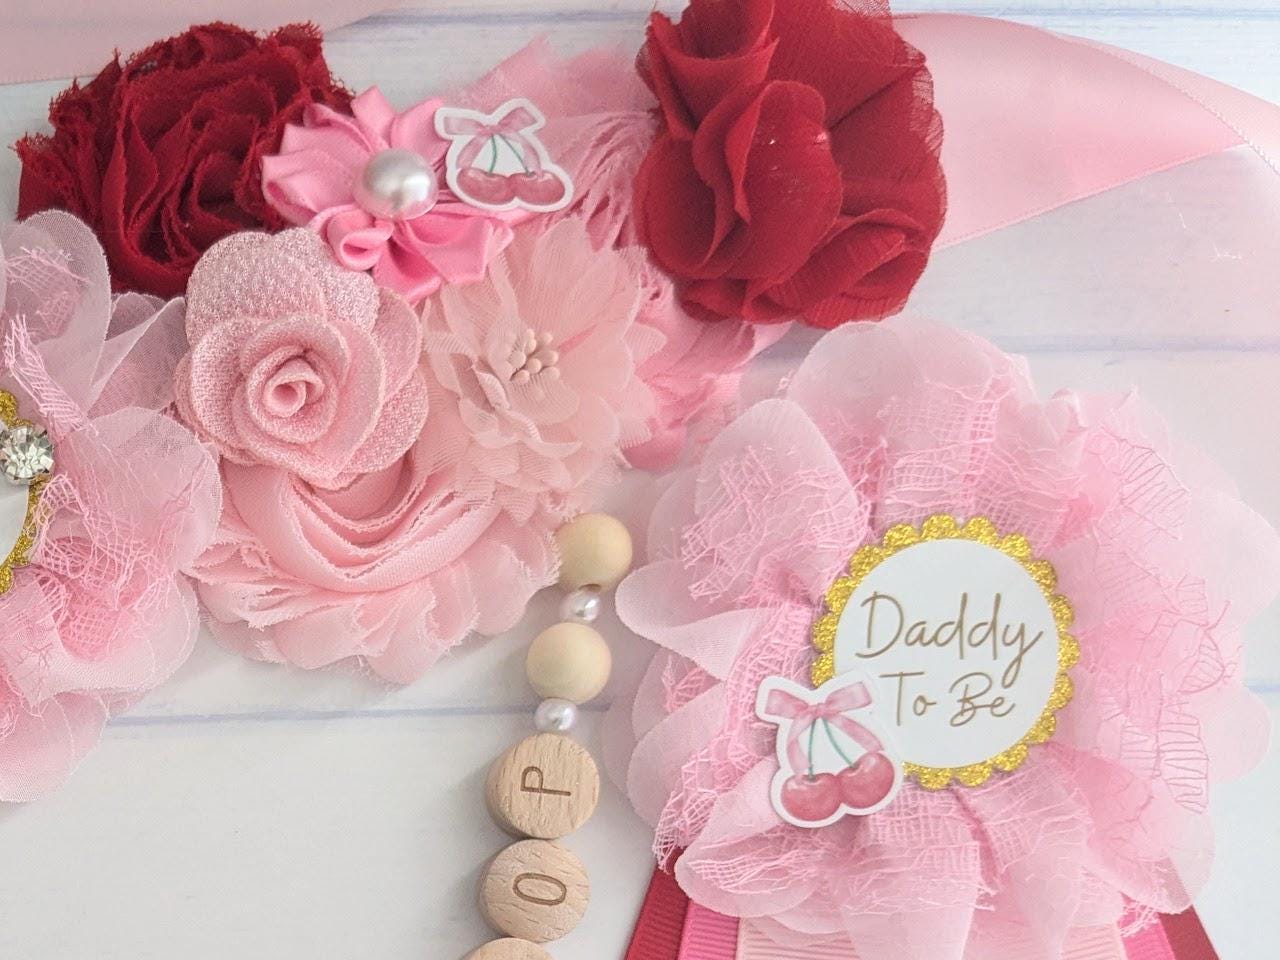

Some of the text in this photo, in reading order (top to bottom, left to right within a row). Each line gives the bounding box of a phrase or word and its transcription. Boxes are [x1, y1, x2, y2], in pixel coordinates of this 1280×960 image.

[855, 591, 1044, 689] Daddy
[879, 672, 1015, 727] To Be
